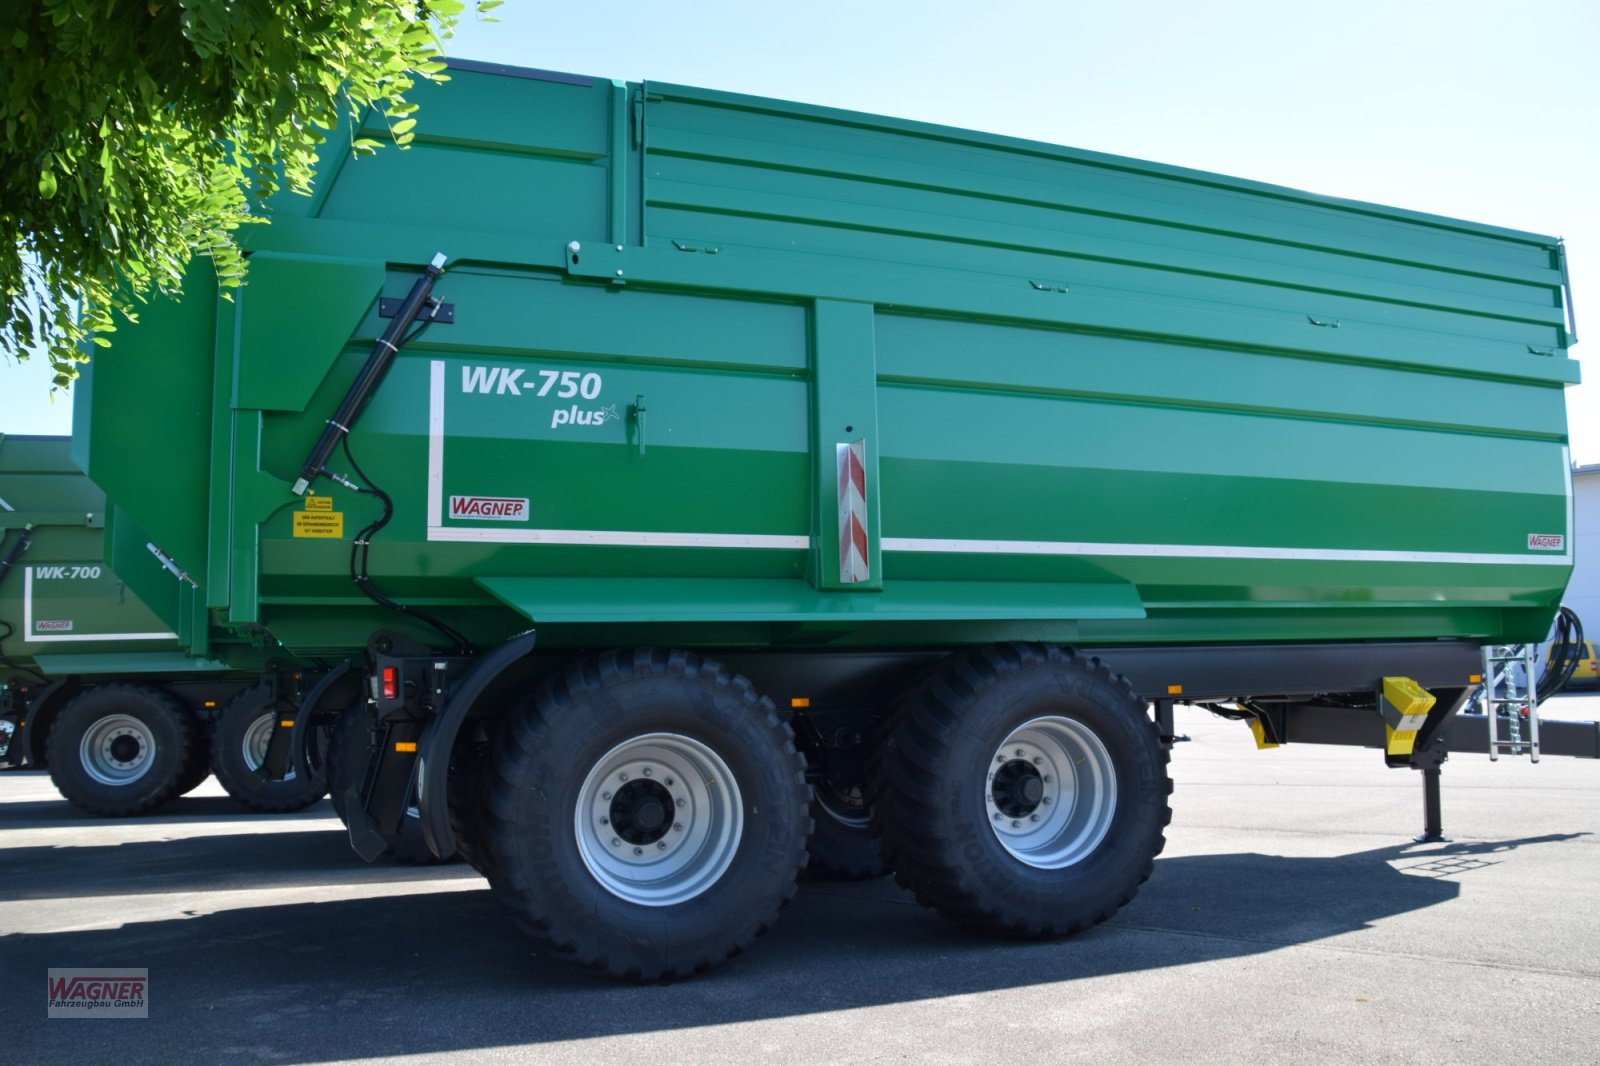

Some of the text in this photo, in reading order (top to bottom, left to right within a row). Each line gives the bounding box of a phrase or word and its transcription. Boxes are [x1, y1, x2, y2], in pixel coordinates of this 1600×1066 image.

[462, 366, 602, 400] WK-750
[551, 405, 604, 428] plus
[452, 497, 525, 516] WAGNER
[1529, 535, 1562, 547] WAGNER
[36, 566, 101, 579] WK-700
